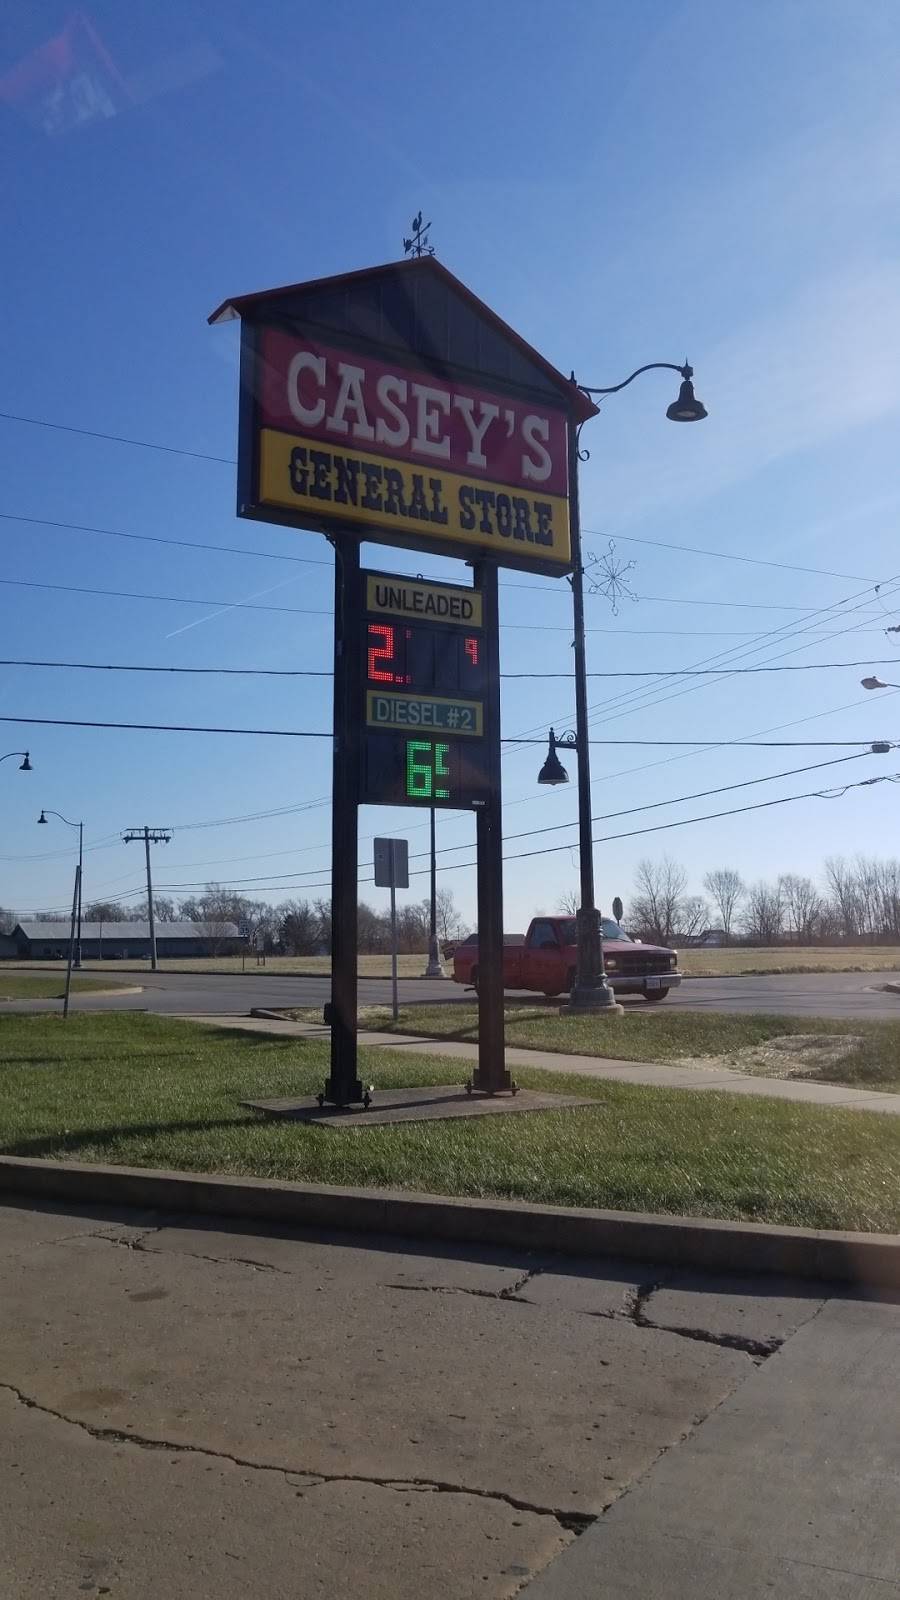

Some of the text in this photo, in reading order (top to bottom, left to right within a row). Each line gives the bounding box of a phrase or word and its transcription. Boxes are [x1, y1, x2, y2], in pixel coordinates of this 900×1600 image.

[287, 351, 552, 481] CASEY'S
[288, 446, 554, 546] GENERAL STORE
[375, 585, 473, 619] UNLEADED
[376, 698, 473, 730] DIESEL #2
